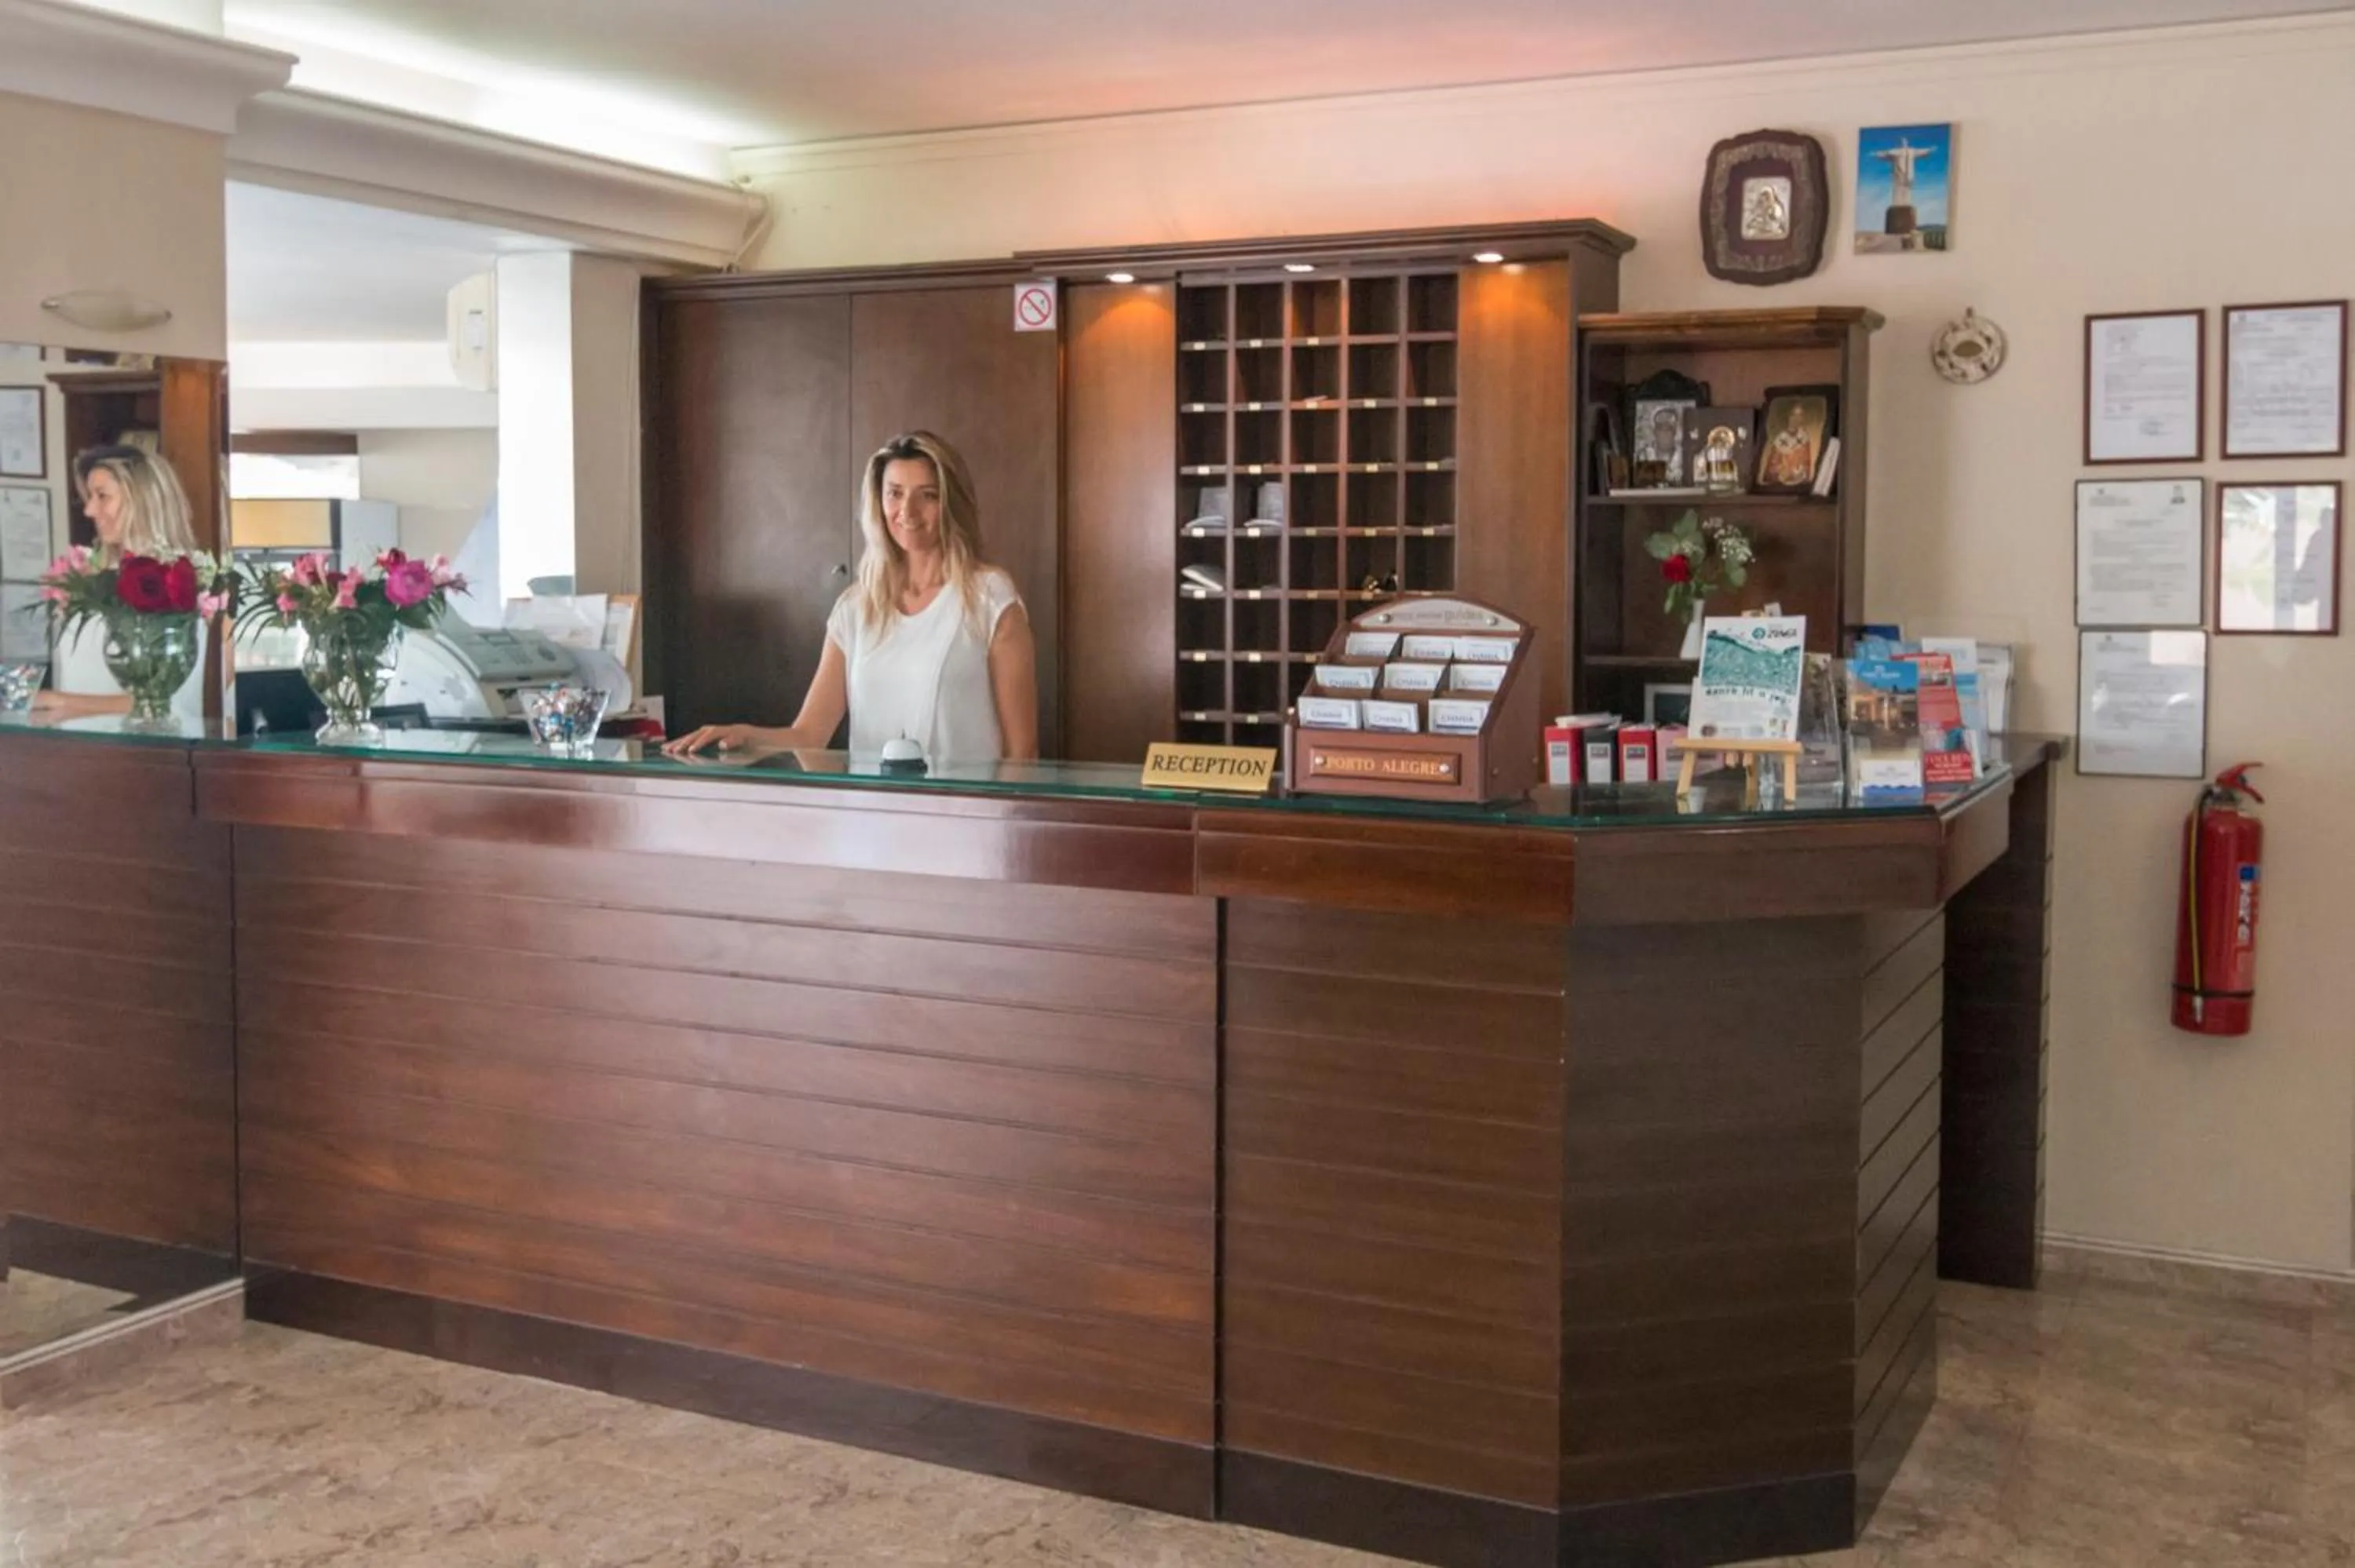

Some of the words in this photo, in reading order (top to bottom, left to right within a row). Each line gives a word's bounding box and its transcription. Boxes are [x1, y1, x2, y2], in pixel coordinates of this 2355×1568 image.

[1151, 753, 1269, 777] RECEPTION
[1324, 757, 1375, 772] PORTO
[1382, 758, 1440, 775] ALEGRE
